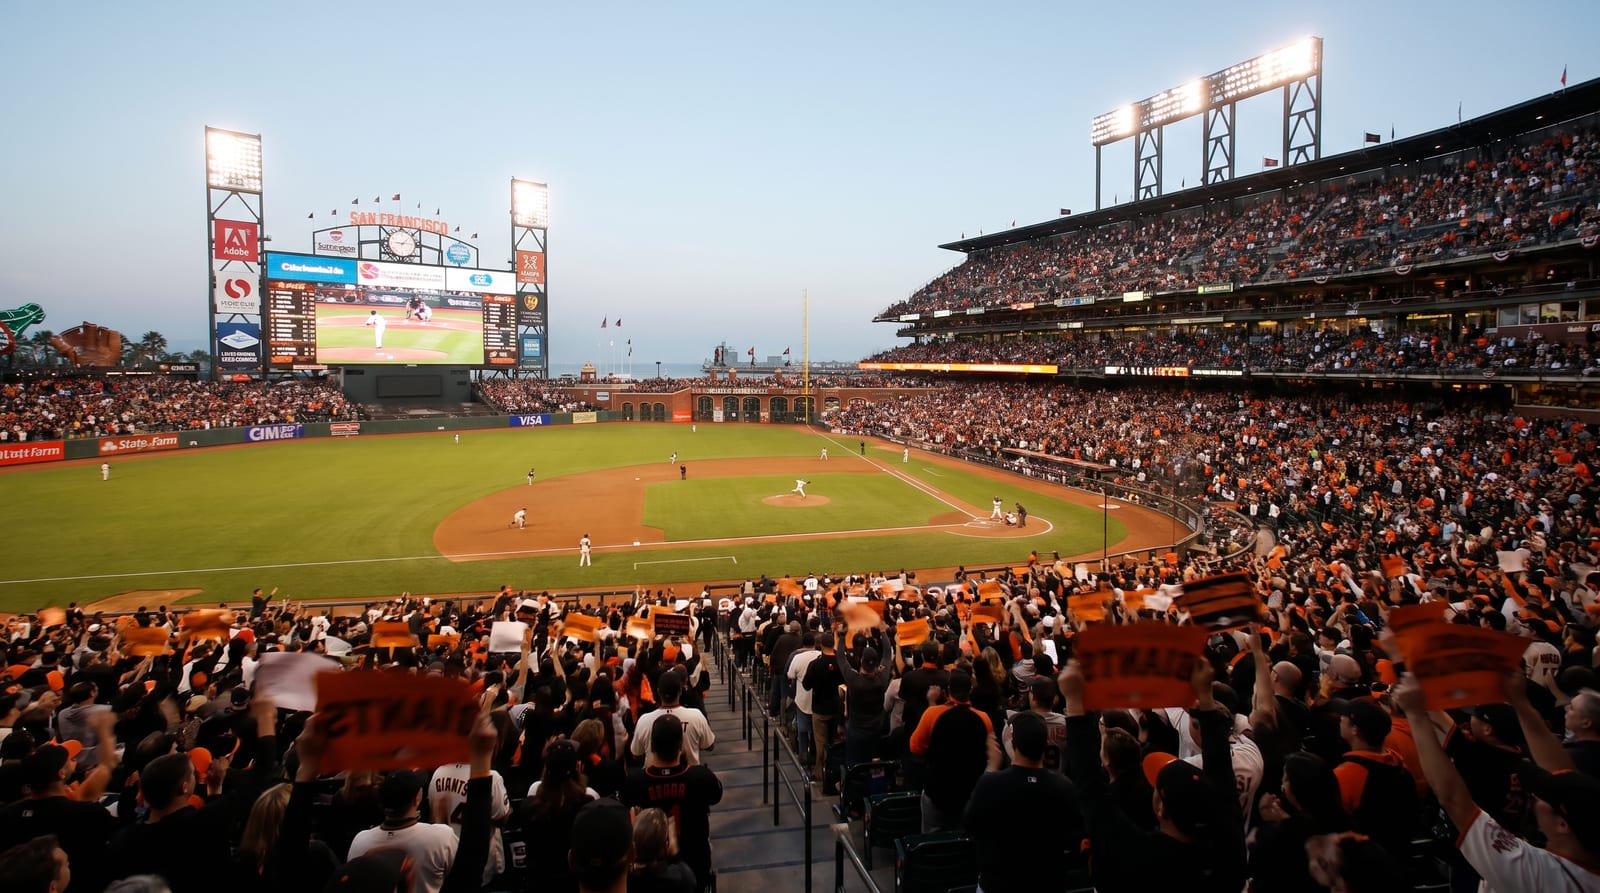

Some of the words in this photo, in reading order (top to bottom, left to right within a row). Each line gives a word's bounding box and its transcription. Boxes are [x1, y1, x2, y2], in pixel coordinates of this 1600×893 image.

[350, 211, 376, 225] SAN
[380, 213, 449, 235] FRANCISCO
[223, 247, 250, 256] Adobe
[518, 415, 542, 426] VISA
[119, 439, 147, 450] State
[151, 437, 178, 447] Farm
[31, 447, 60, 457] Farm
[435, 777, 468, 796] GIANTS
